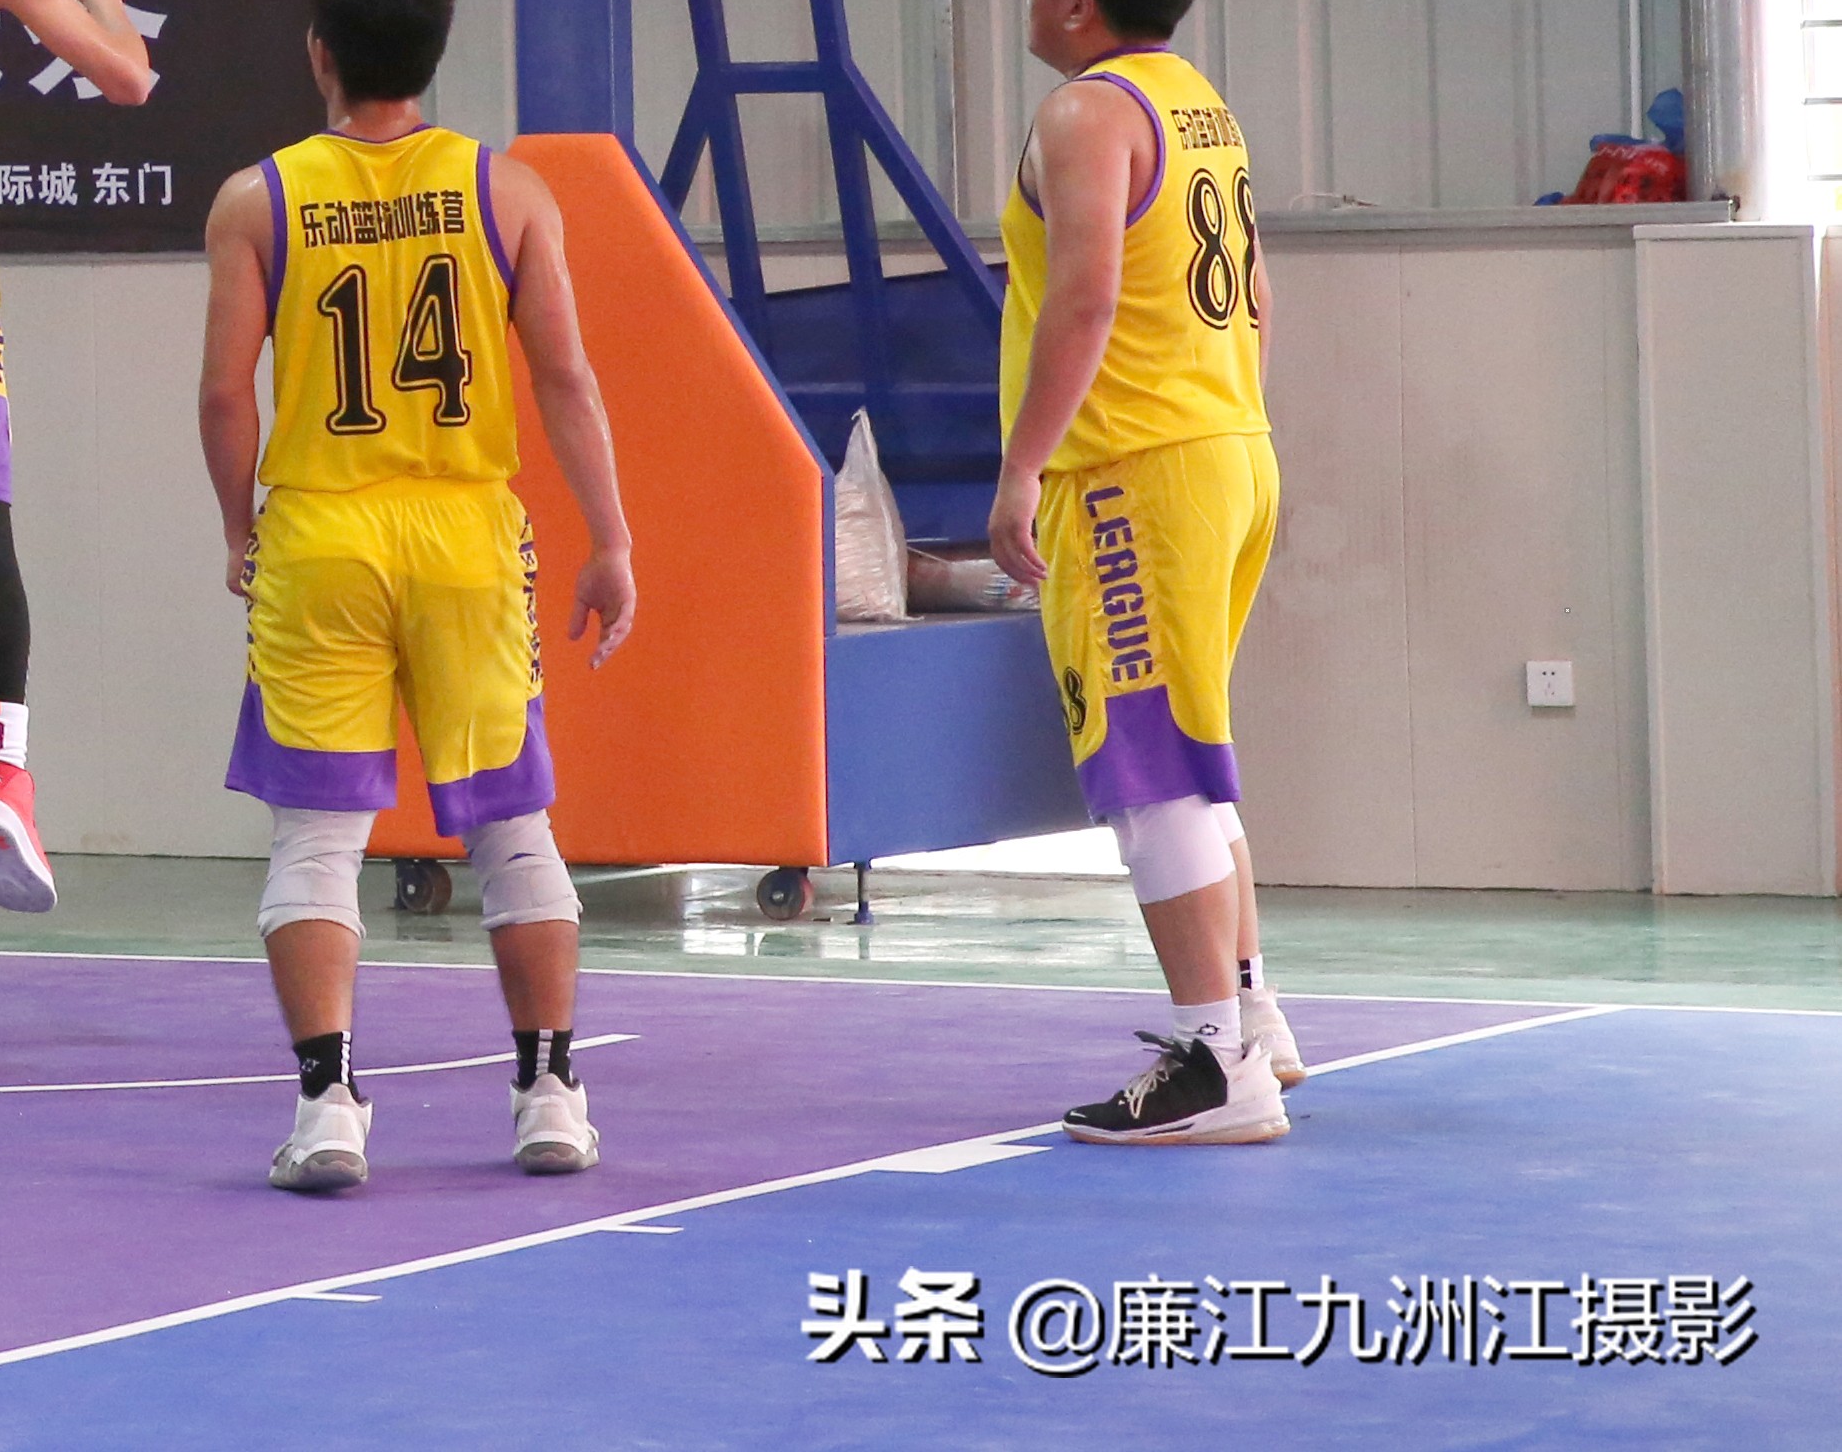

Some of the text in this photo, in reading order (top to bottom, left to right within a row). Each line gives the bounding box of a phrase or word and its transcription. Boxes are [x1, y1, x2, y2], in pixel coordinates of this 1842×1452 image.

[92, 161, 173, 206] 东门
[299, 189, 466, 249] 乐动篮球训练营
[316, 253, 473, 436] 14
[1085, 485, 1154, 684] LEAGUE
